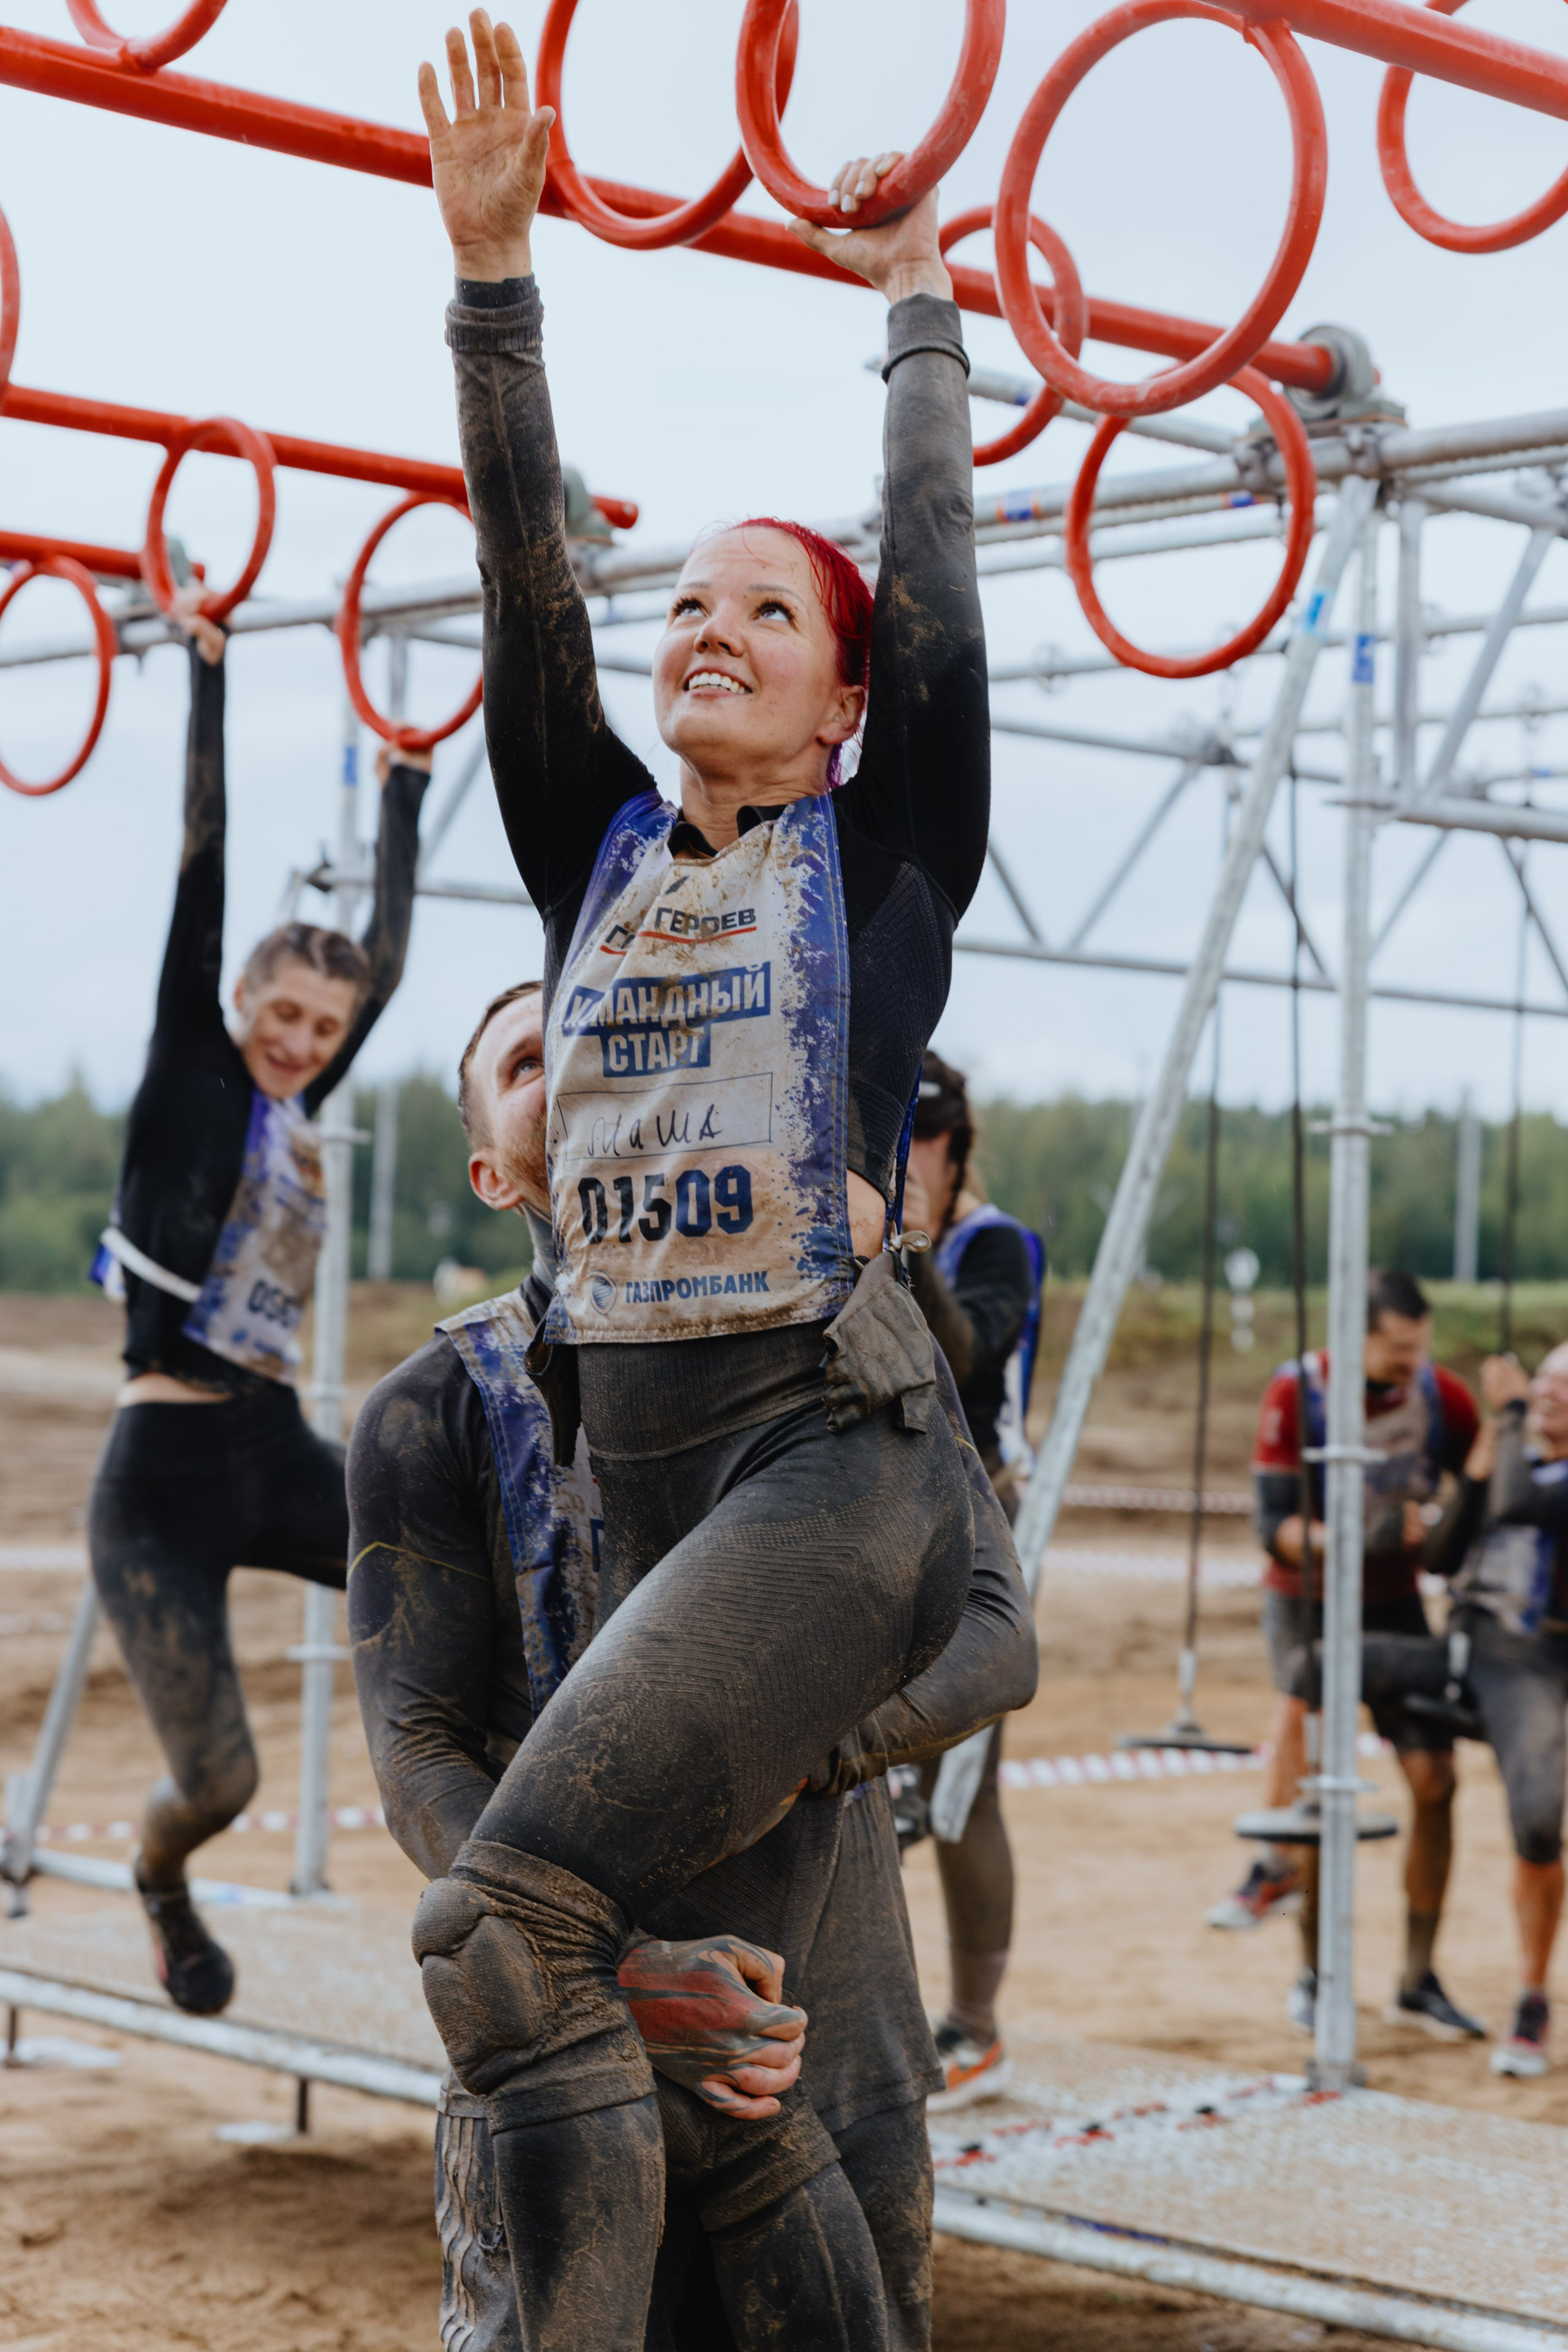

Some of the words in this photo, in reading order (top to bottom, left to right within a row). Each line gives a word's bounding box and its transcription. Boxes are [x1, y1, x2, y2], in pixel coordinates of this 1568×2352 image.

[608, 1027, 704, 1072] СТАРТ
[578, 1164, 754, 1245] 01509
[625, 1270, 770, 1303] ГАЗПРОМБАНК
